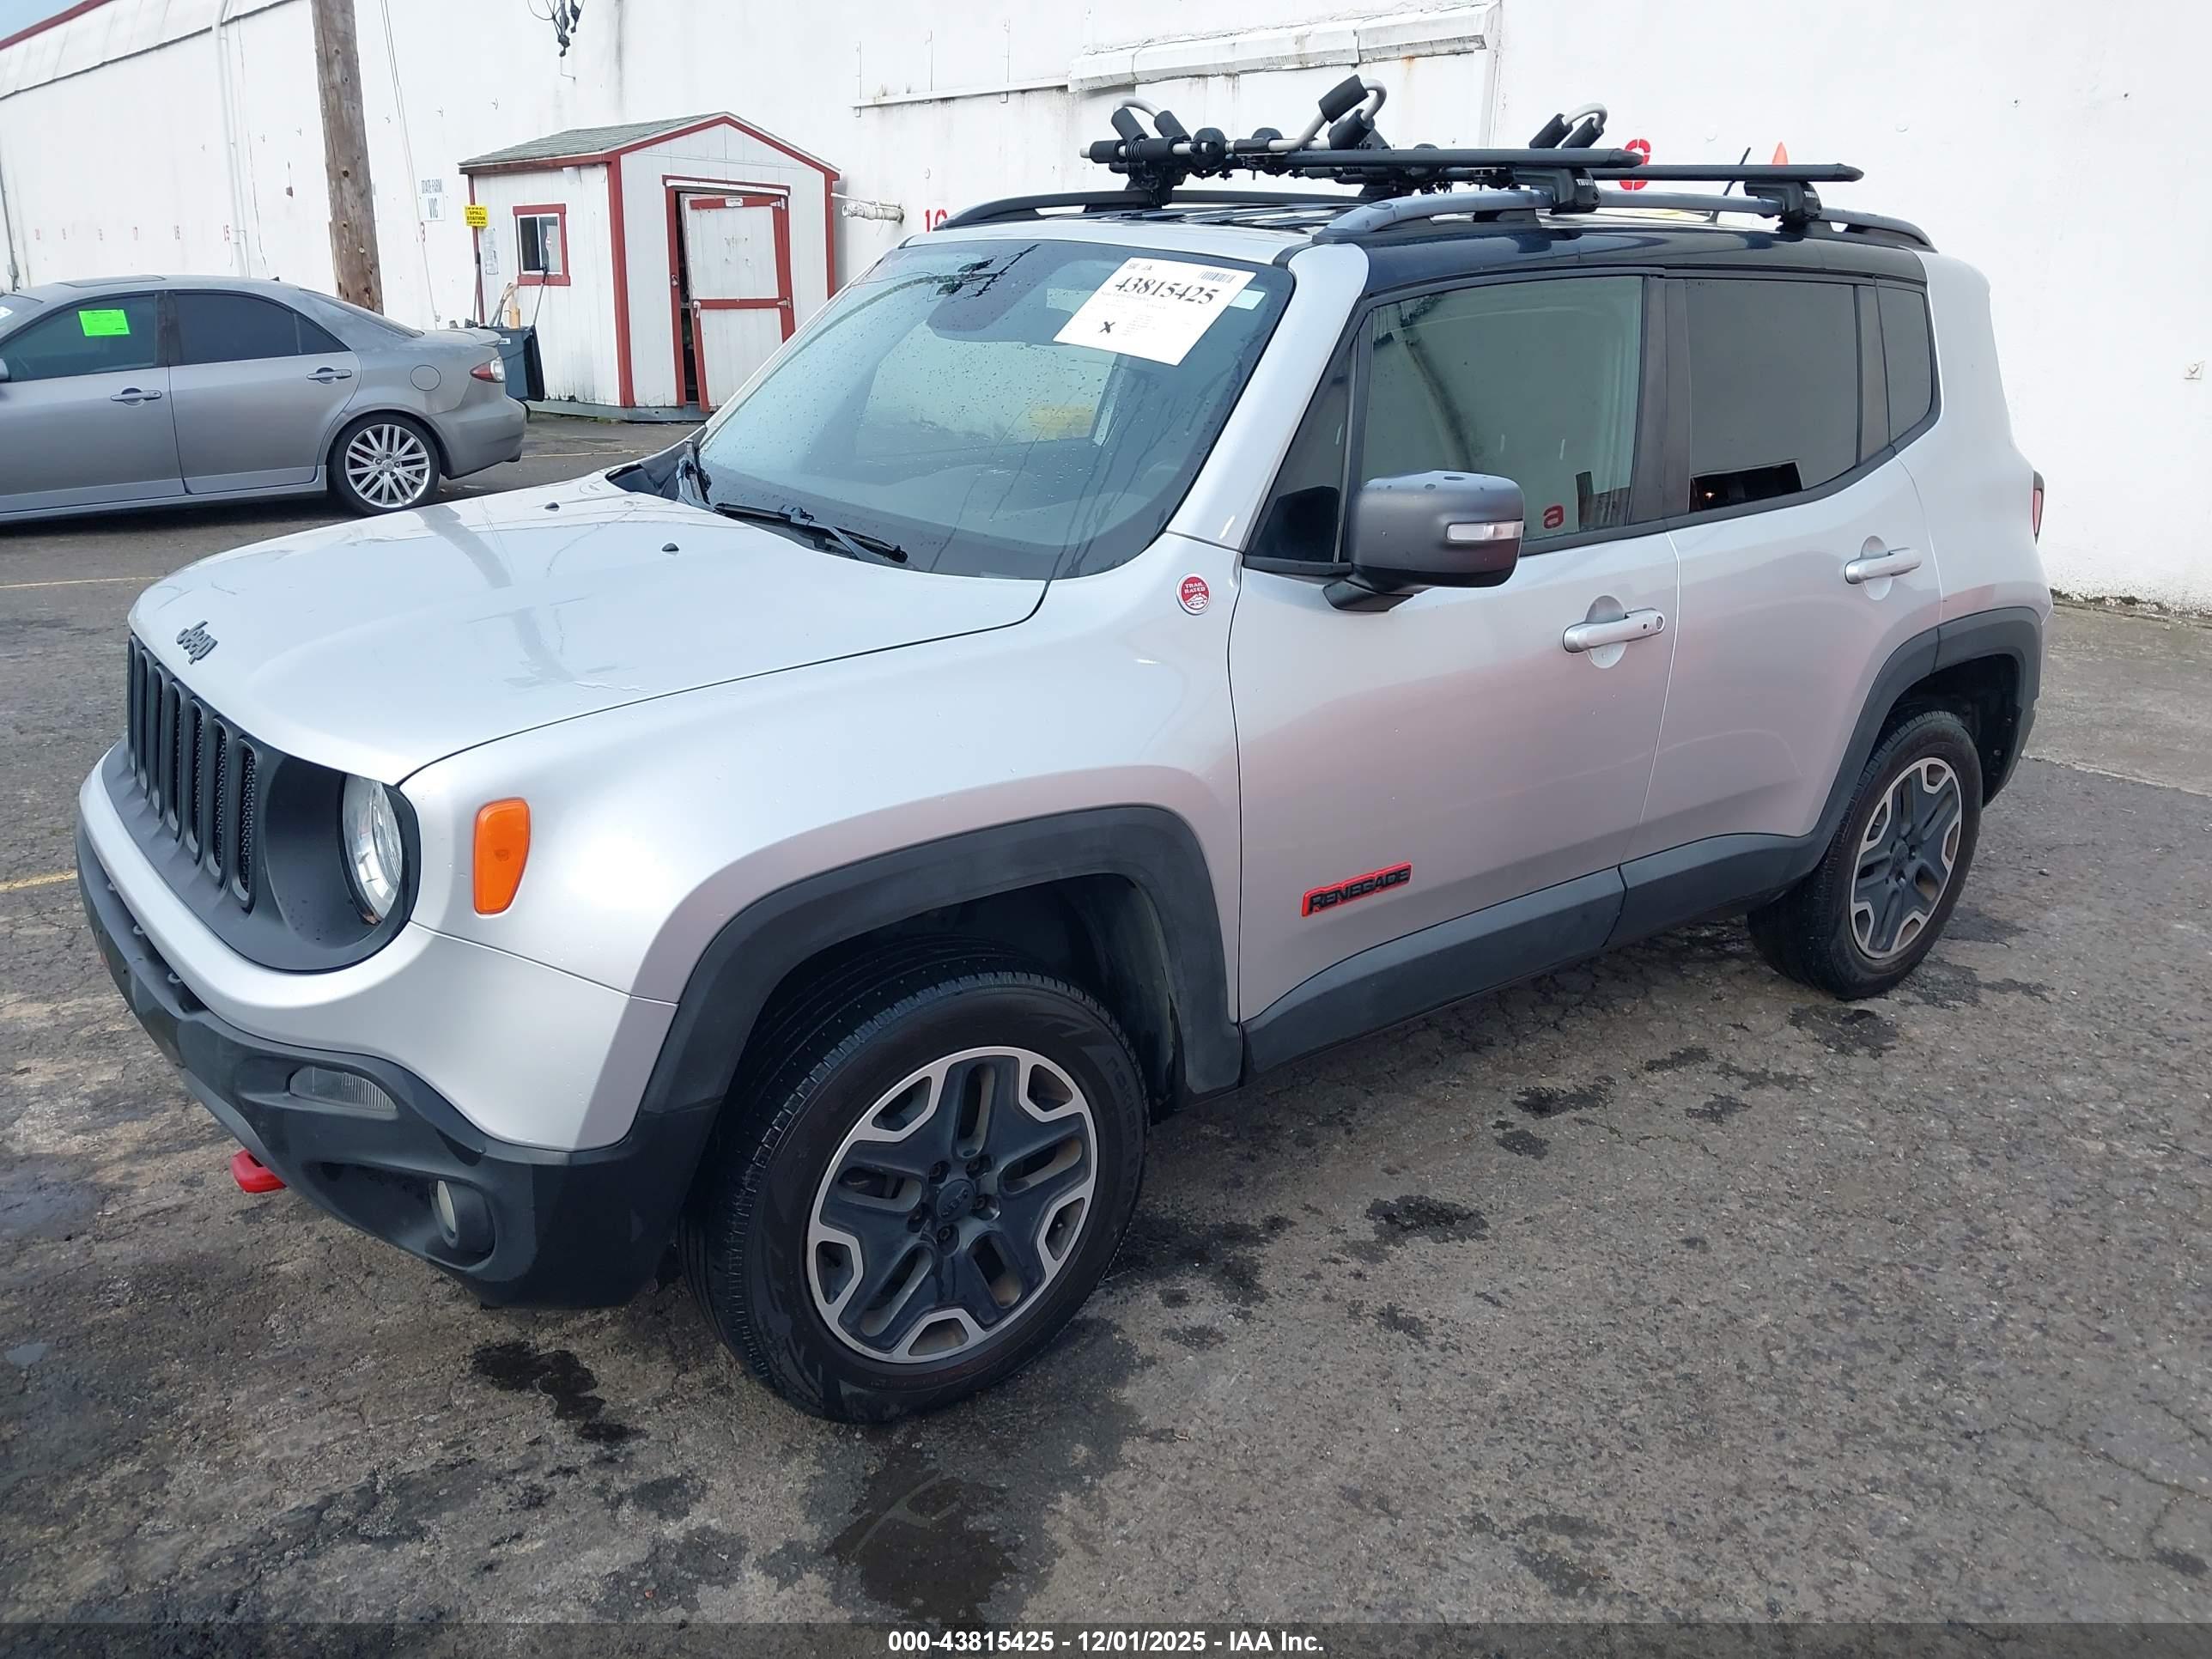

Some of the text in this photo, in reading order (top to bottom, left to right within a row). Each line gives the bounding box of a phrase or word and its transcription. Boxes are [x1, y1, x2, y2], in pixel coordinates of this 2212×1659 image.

[1115, 276, 1221, 305] 43815425
[176, 620, 218, 665] Jeep
[1309, 866, 1412, 915] RENEGADE
